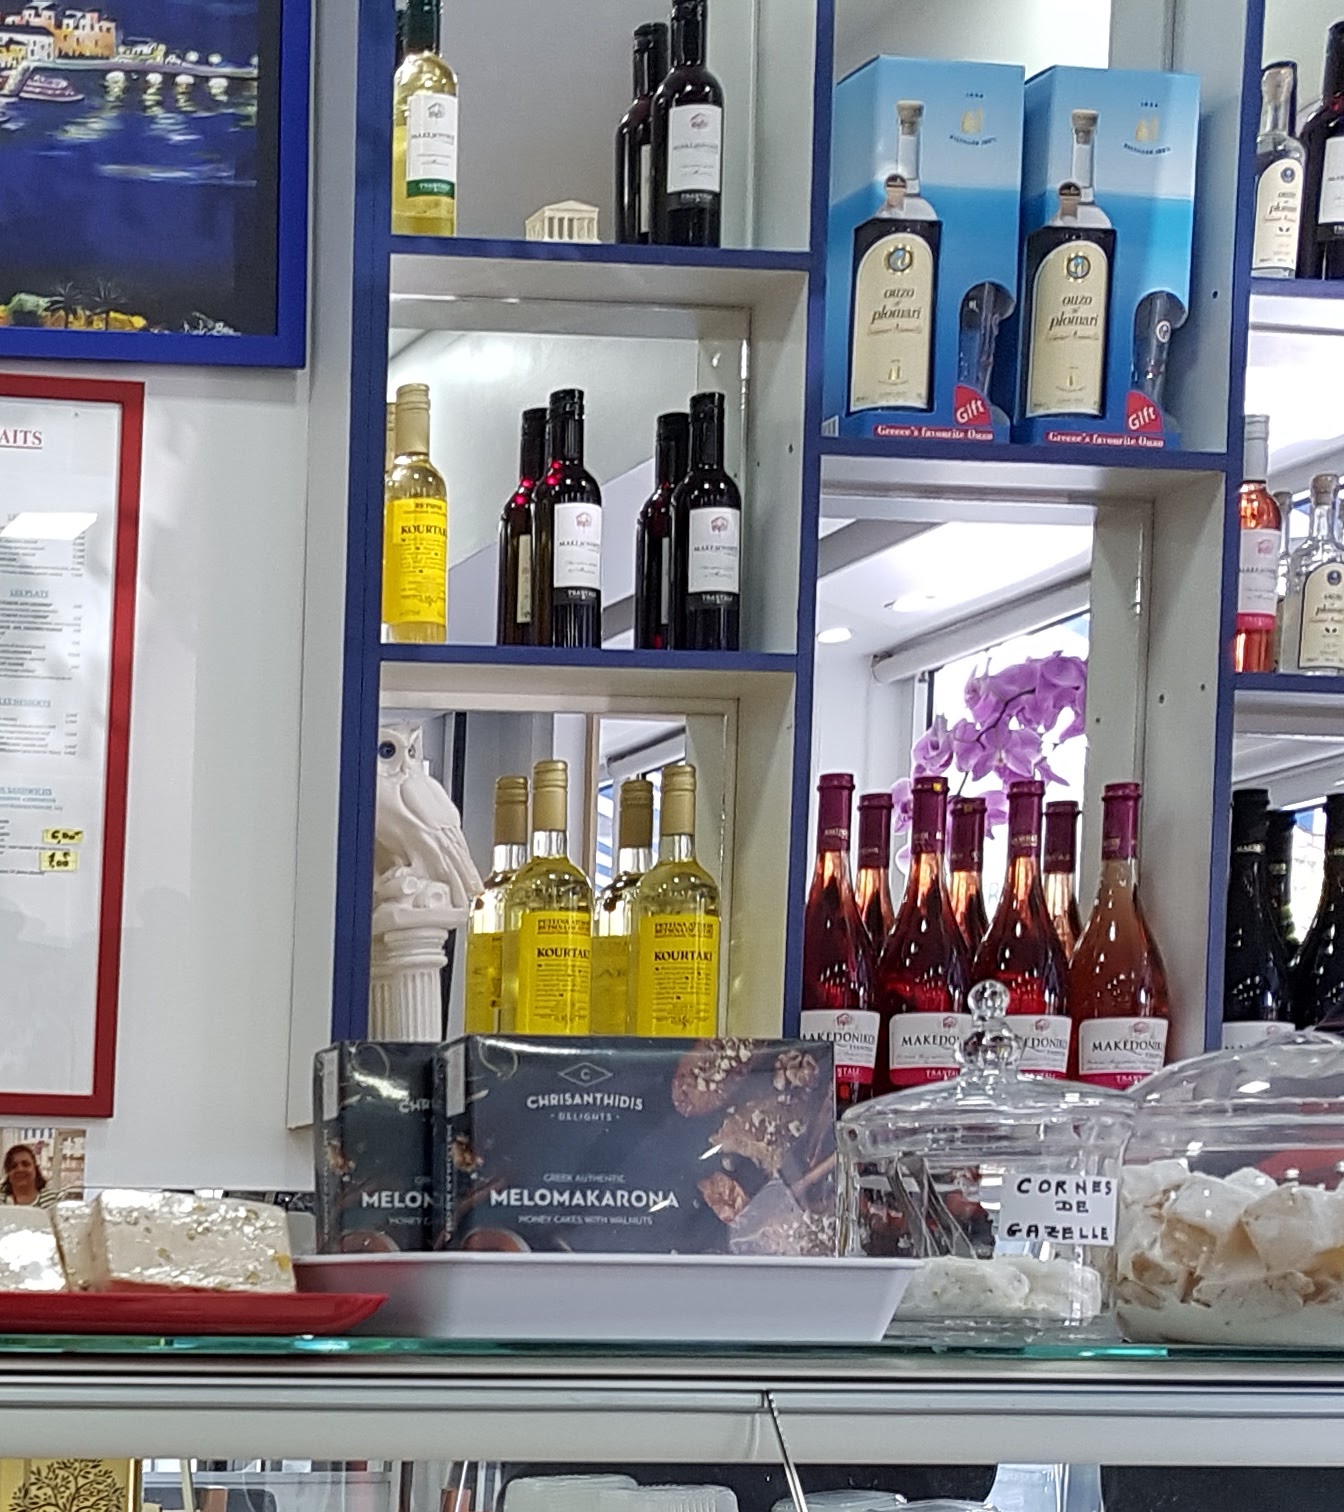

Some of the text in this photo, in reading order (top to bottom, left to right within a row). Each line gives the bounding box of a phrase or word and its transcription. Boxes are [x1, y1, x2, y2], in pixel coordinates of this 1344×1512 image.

[884, 287, 914, 298] ouzo
[1063, 295, 1092, 306] ouzo
[527, 1093, 643, 1110] CHRISANTHIDIS
[559, 1112, 612, 1121] DELIGHTS
[1016, 1176, 1113, 1198] CORNES
[490, 1188, 679, 1208] MELOMAKARONA
[1055, 1200, 1089, 1215] DE
[1006, 1223, 1109, 1241] GAZELLE
